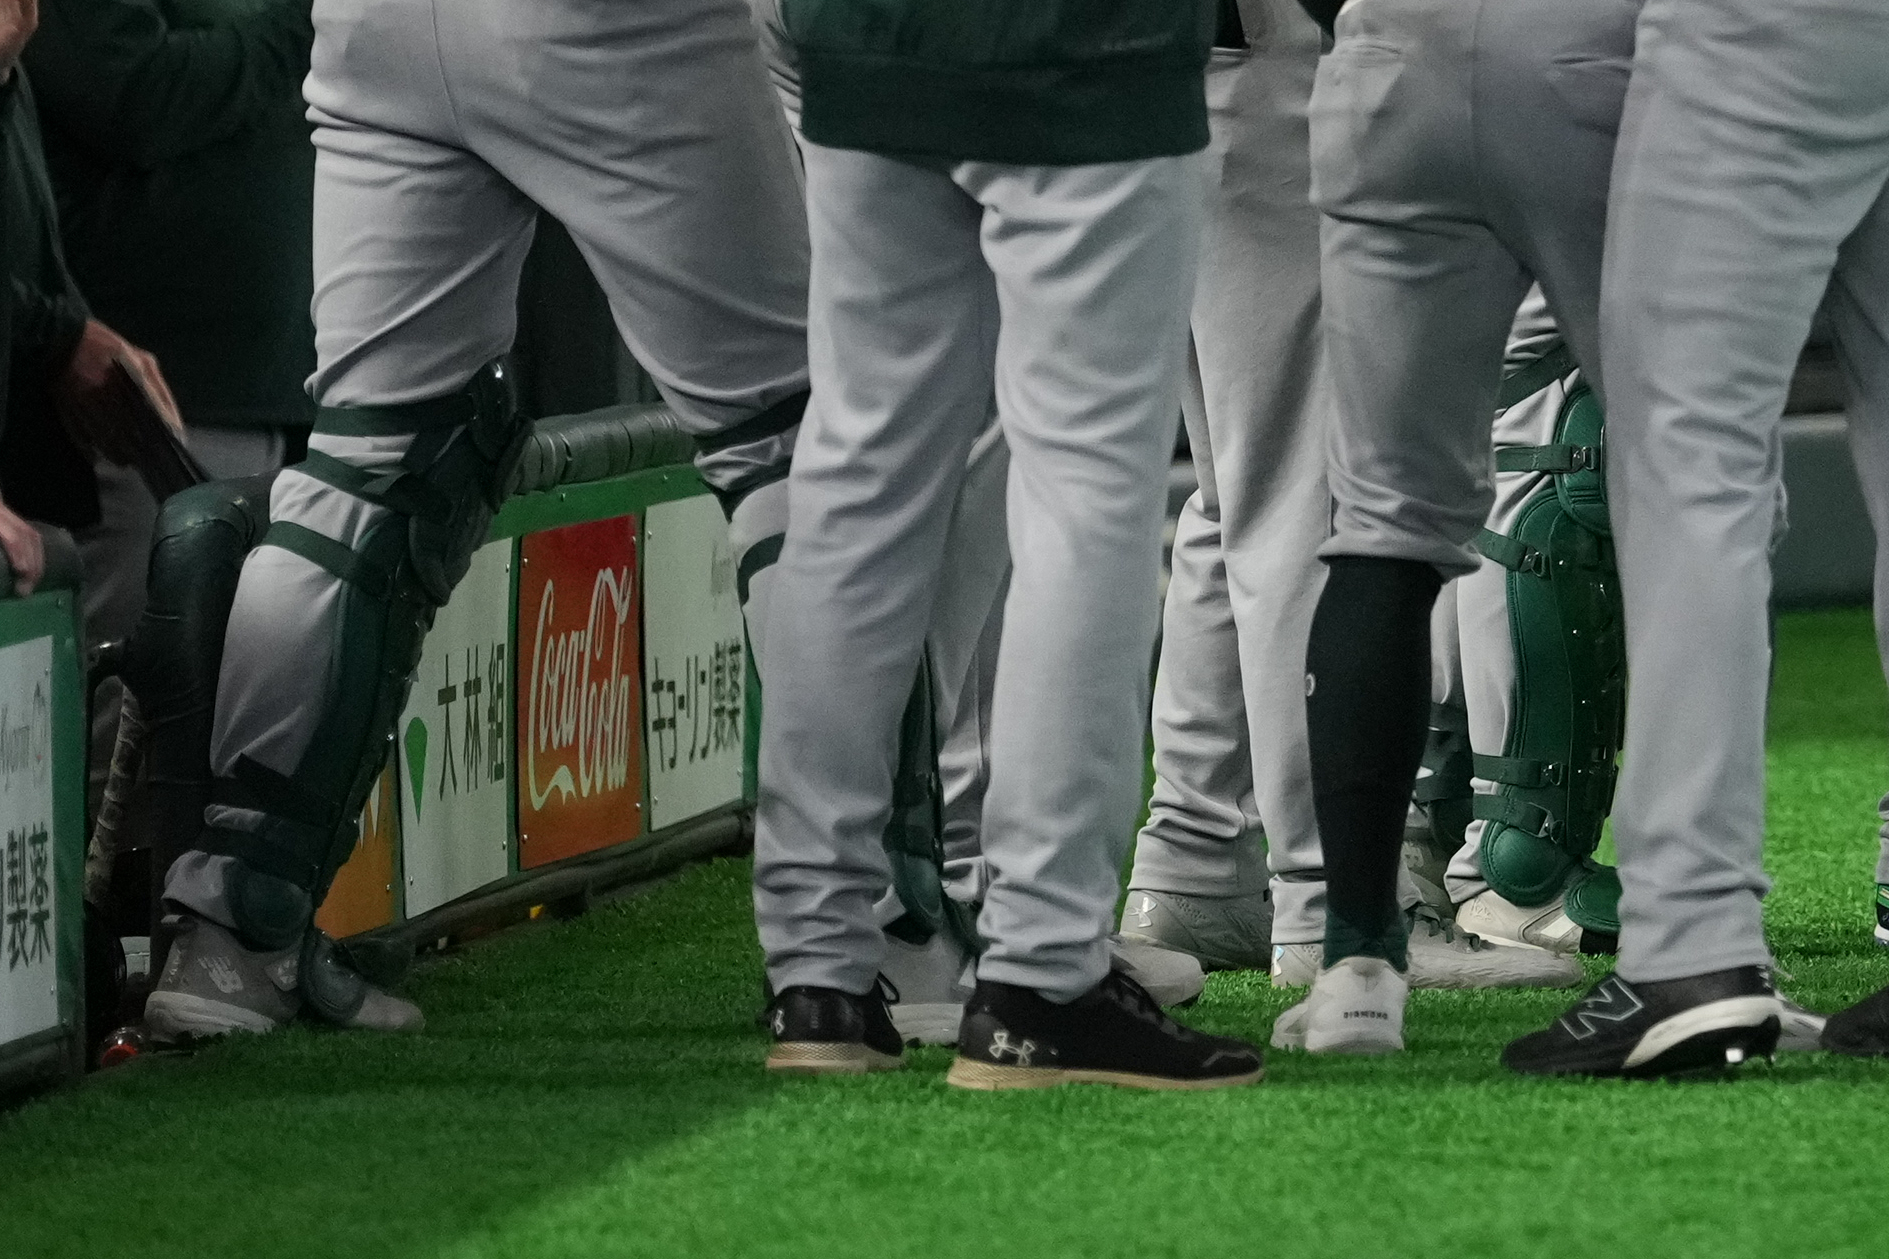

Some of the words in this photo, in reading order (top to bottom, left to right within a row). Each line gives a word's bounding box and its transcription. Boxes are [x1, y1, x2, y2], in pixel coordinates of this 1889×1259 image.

[437, 641, 507, 803] 大林組
[528, 565, 633, 811] Coca-Cola
[651, 637, 741, 774] キョーリン製薬
[0, 820, 51, 974] 製薬
